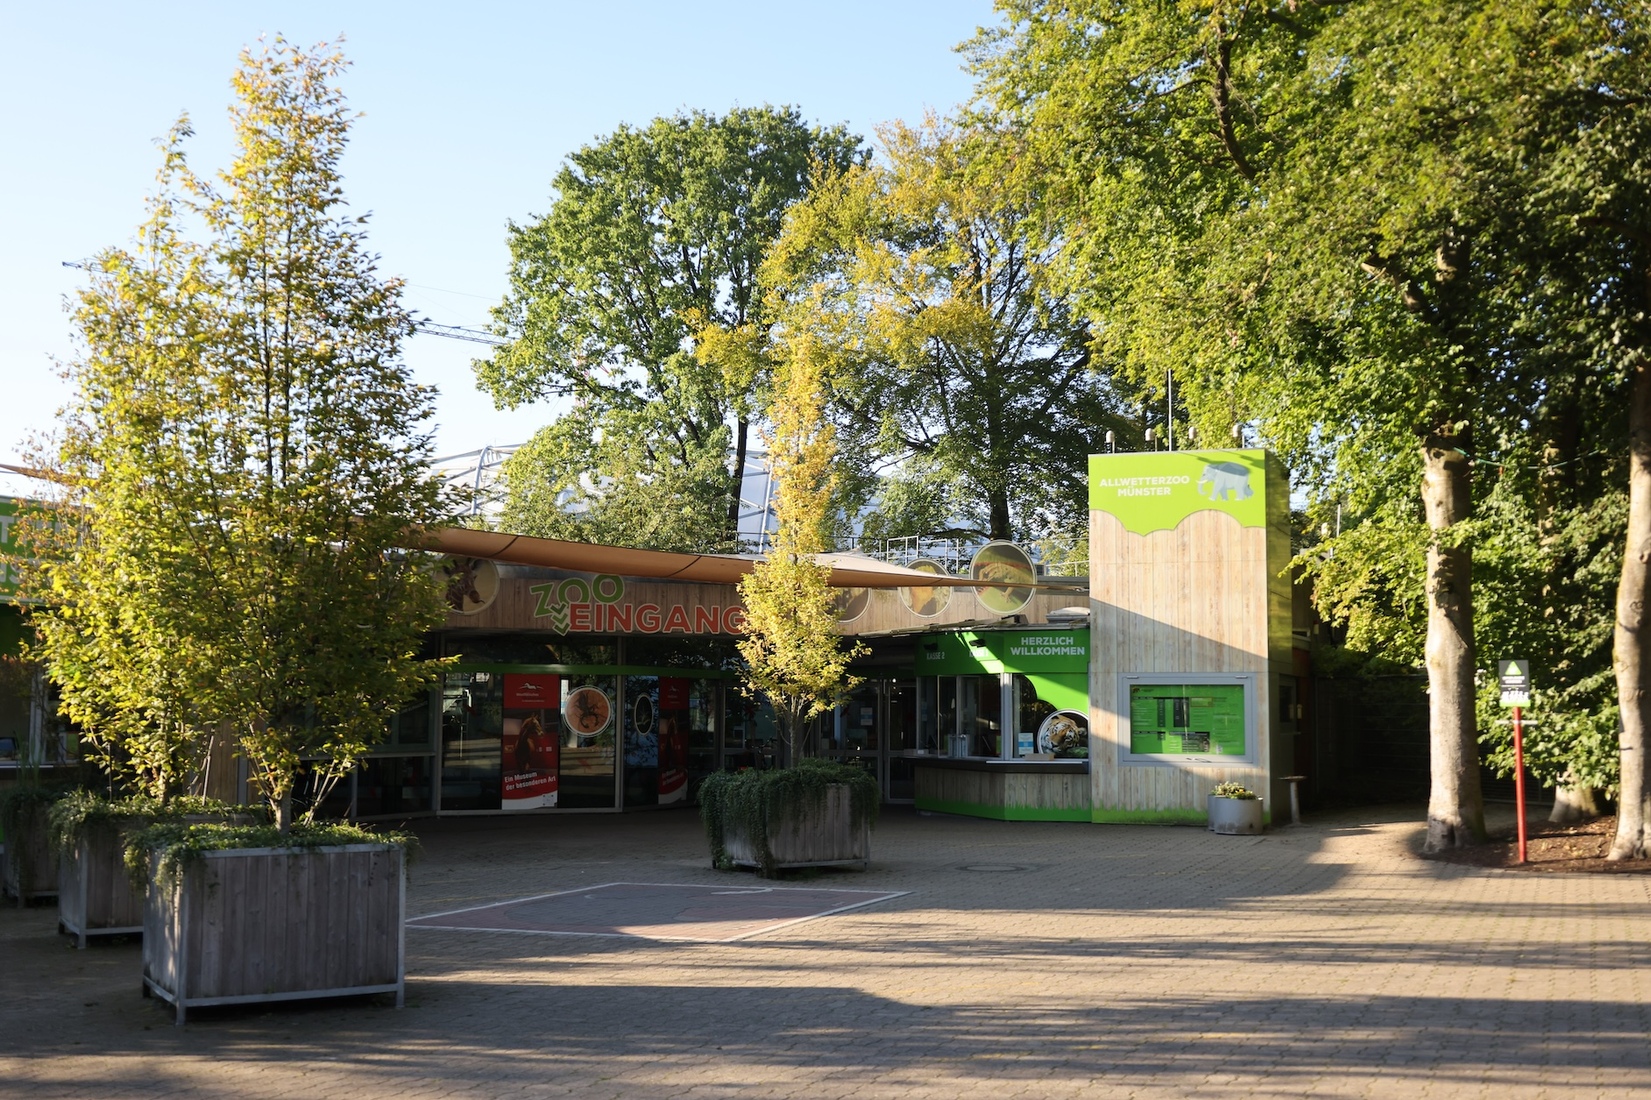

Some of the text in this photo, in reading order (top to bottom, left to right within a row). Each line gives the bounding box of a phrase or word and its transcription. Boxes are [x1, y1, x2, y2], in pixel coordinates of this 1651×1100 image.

[1099, 475, 1190, 487] ALLWETTERZOO
[1117, 486, 1171, 497] MÜNSTER
[530, 574, 624, 617] ZOO
[570, 603, 745, 635] EINGANG
[1021, 636, 1074, 646] HERZLICH
[926, 651, 946, 660] KASSE 2
[1010, 646, 1085, 656] WILLKOMMEN
[514, 772, 537, 780] Museum
[516, 779, 547, 788] besonderen
[547, 775, 556, 783] Art
